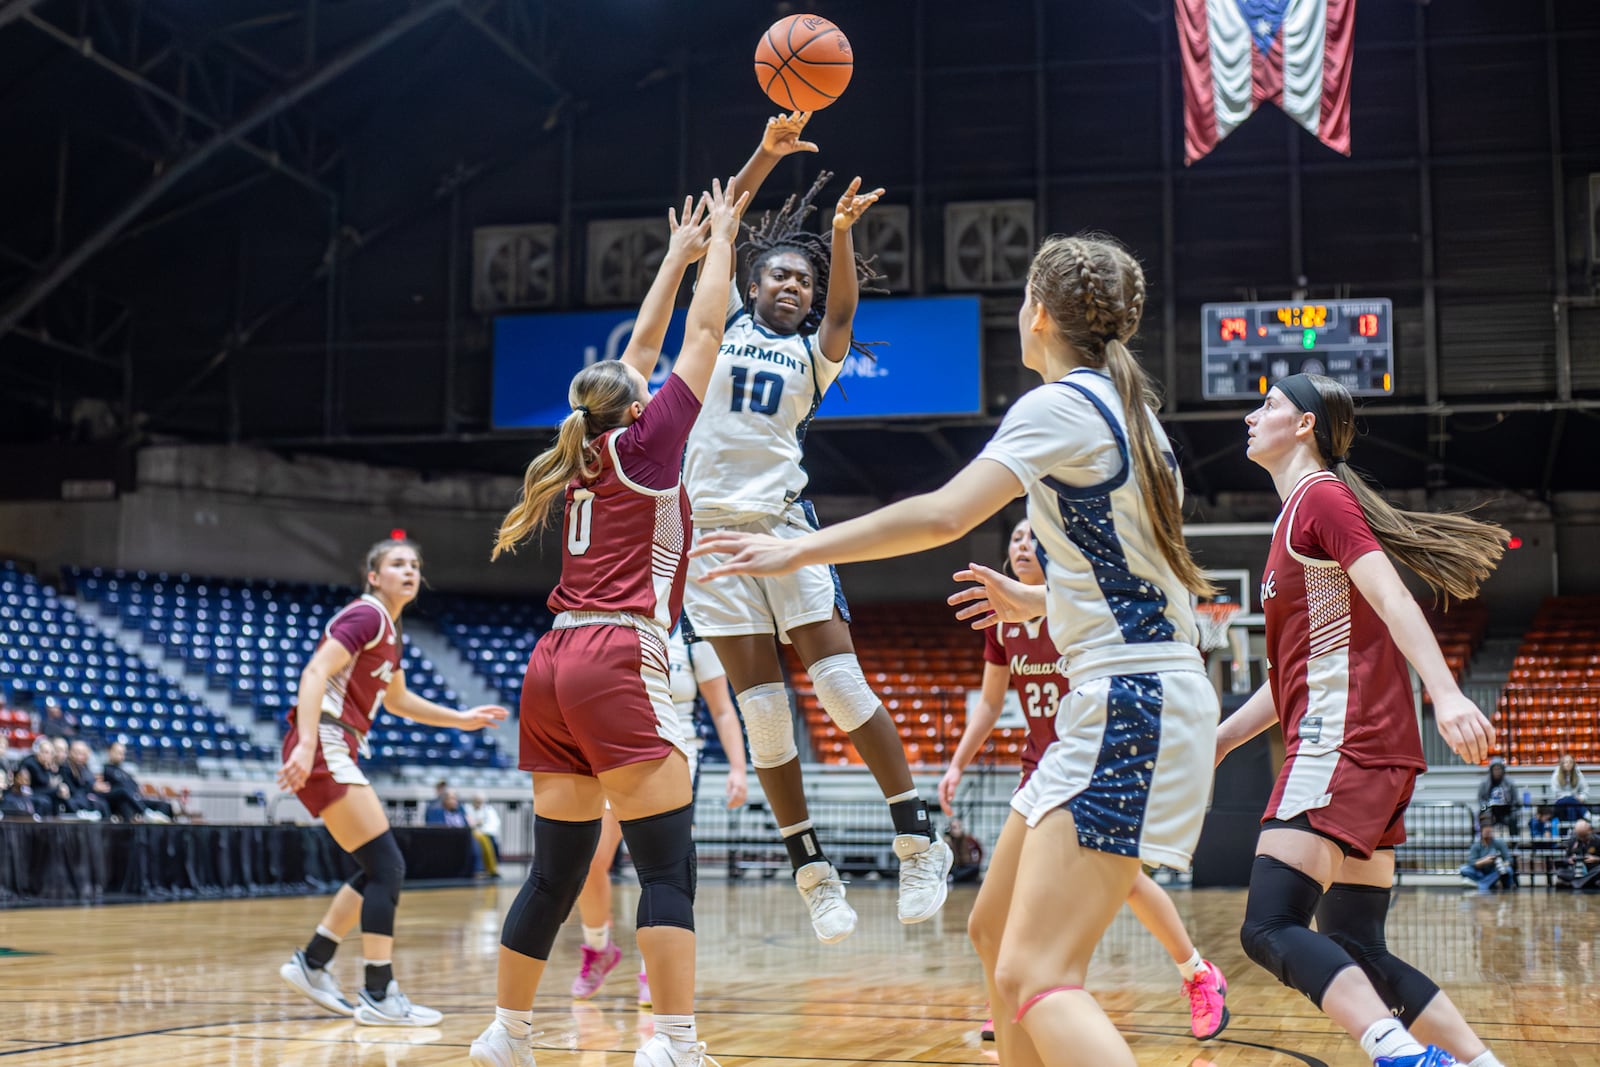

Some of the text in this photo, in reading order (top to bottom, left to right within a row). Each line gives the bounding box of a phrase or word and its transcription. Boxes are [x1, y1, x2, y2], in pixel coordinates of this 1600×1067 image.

[718, 344, 807, 374] FAIRMONT
[729, 365, 785, 416] 10
[567, 487, 596, 556] 0
[1009, 654, 1061, 676] Newar
[1024, 682, 1060, 718] 23
